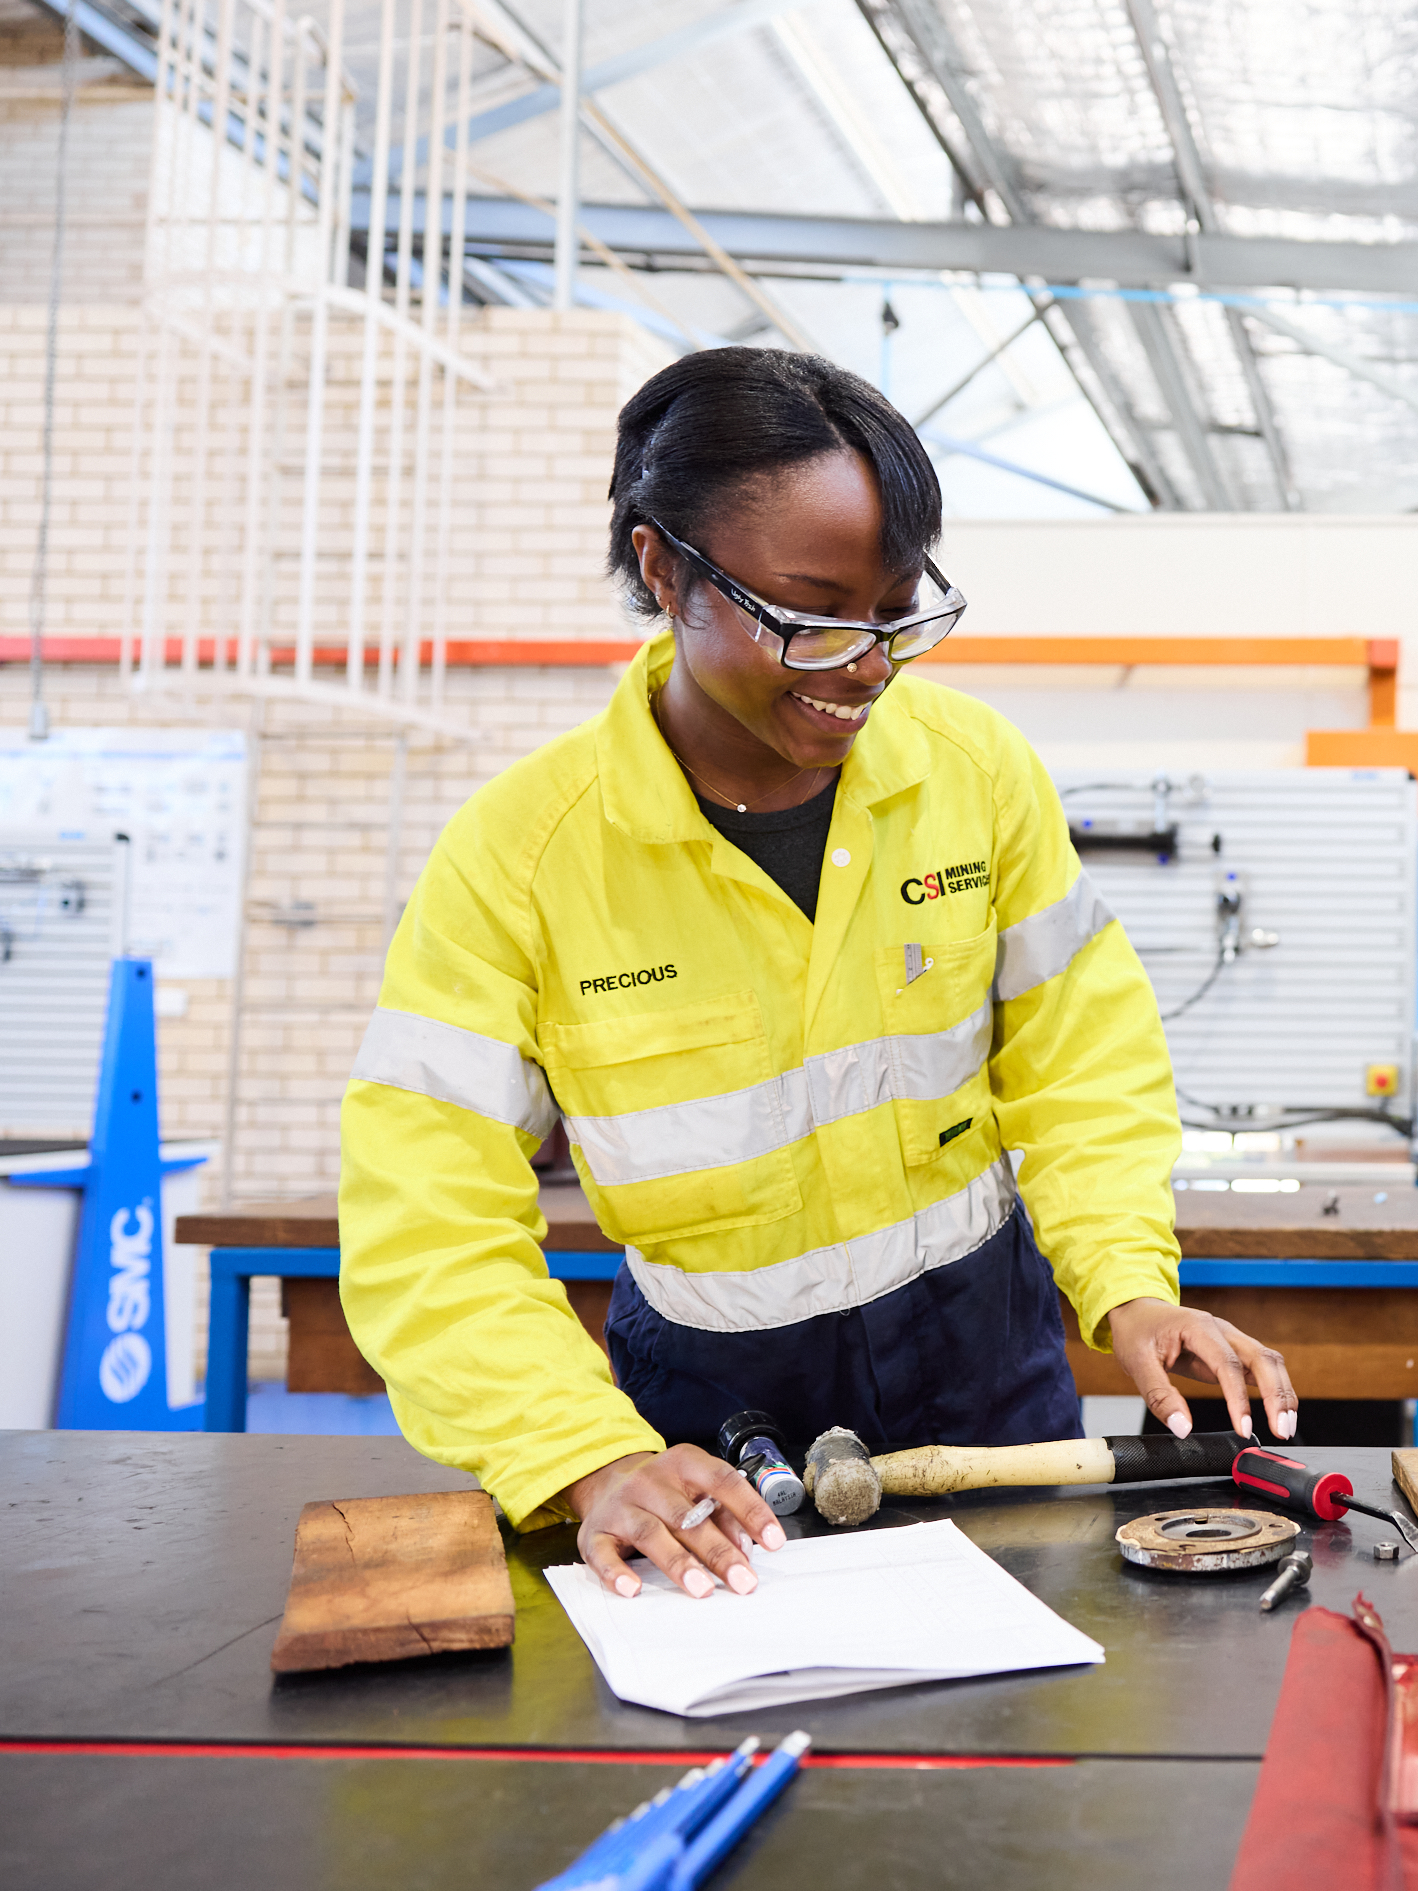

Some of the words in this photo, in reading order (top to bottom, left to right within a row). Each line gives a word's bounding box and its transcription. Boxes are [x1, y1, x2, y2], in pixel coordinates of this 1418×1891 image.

[945, 861, 986, 880] MINING
[900, 871, 946, 906] CSI
[579, 964, 678, 996] PRECIOUS
[106, 1204, 154, 1334] SMC
